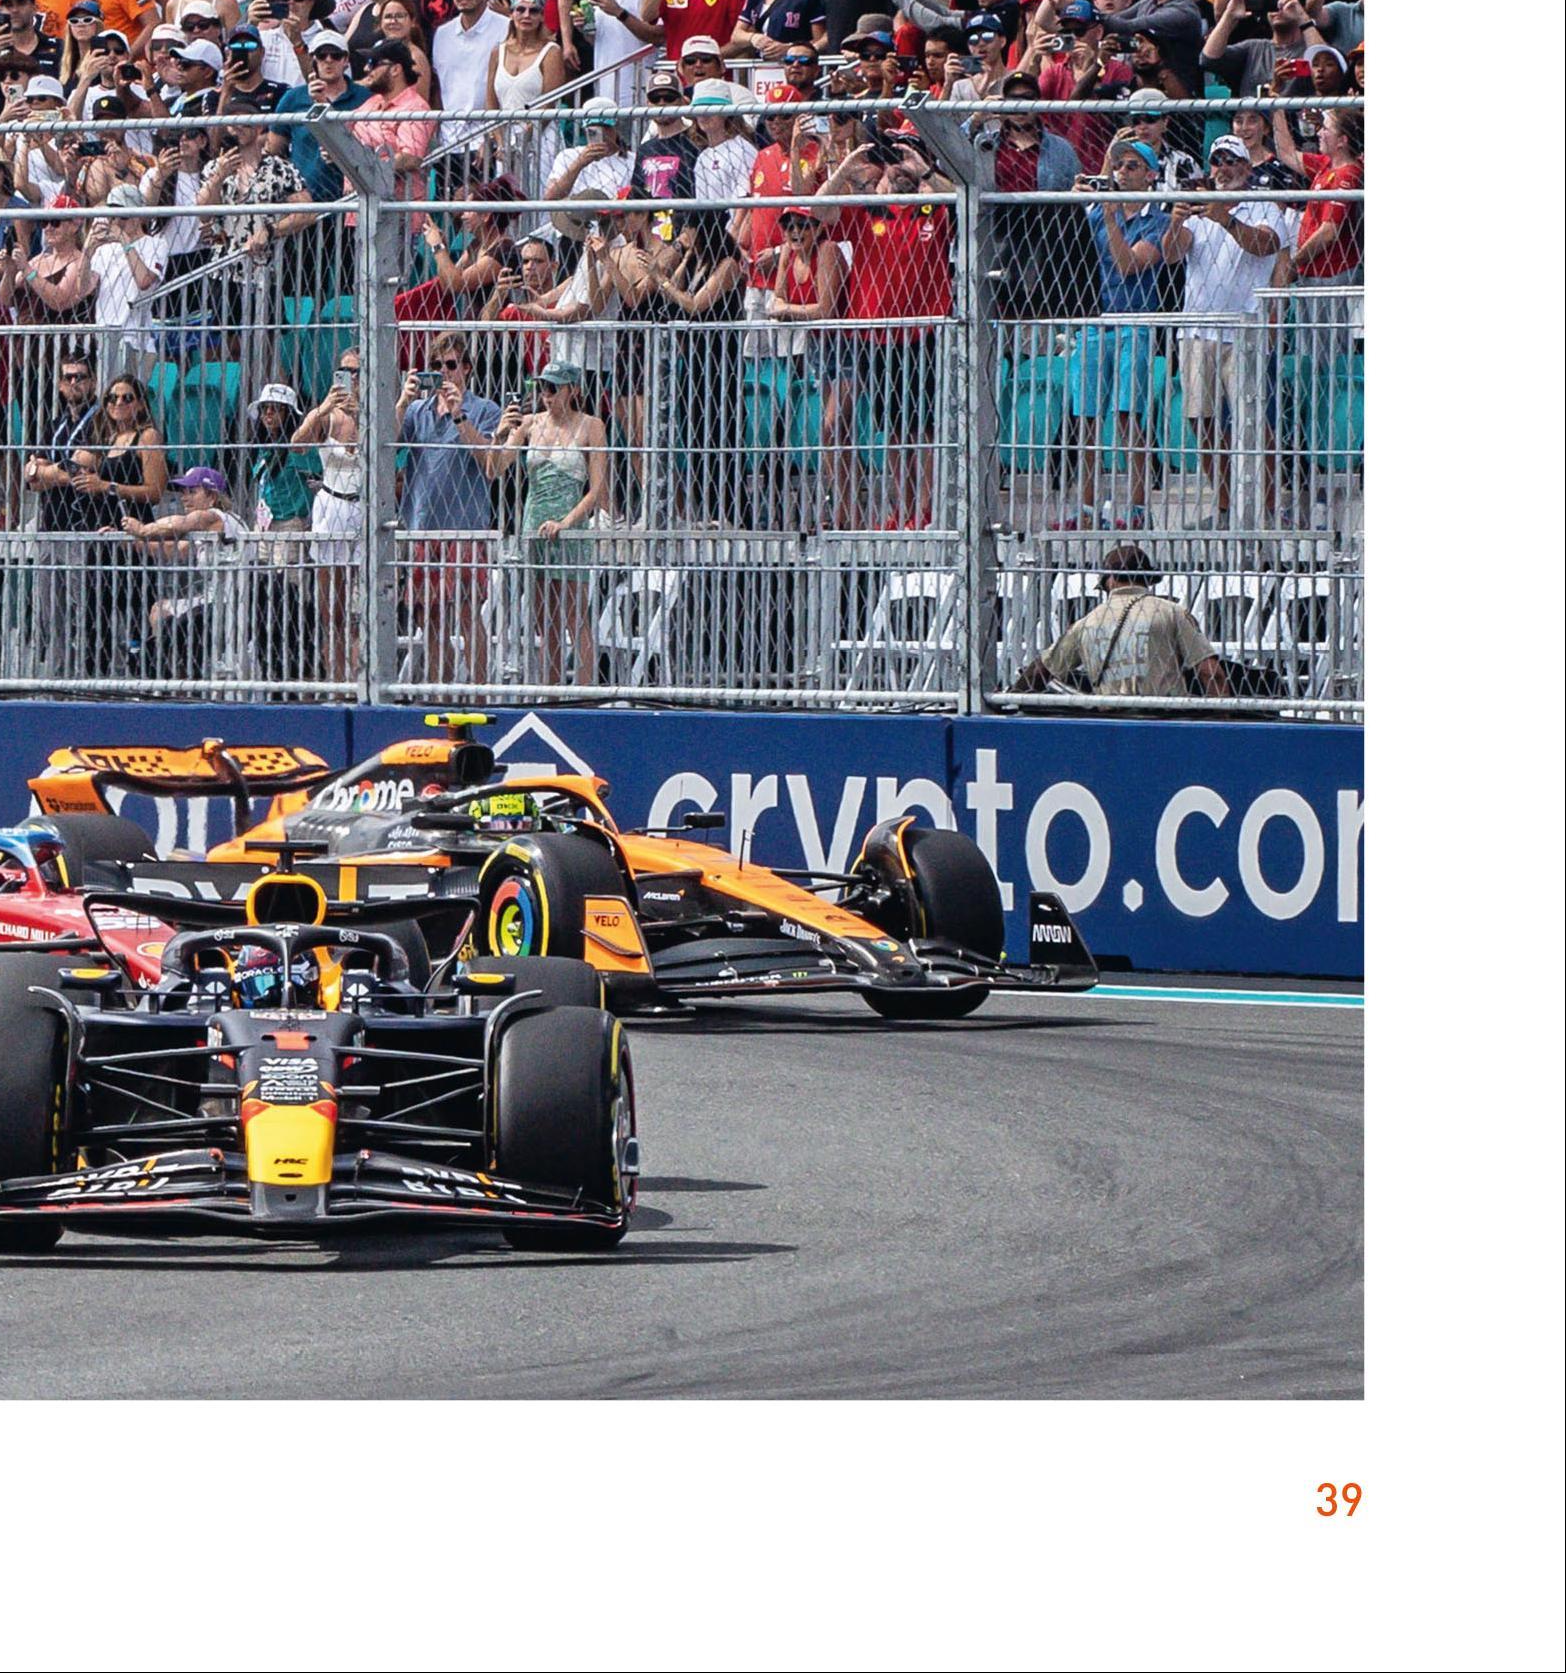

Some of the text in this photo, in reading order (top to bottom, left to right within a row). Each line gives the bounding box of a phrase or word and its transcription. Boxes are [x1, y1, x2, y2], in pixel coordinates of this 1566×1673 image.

[312, 778, 415, 811] Chrome
[647, 749, 1364, 923] cryto.co
[593, 914, 620, 927] VELO
[1316, 1482, 1362, 1516] 39
